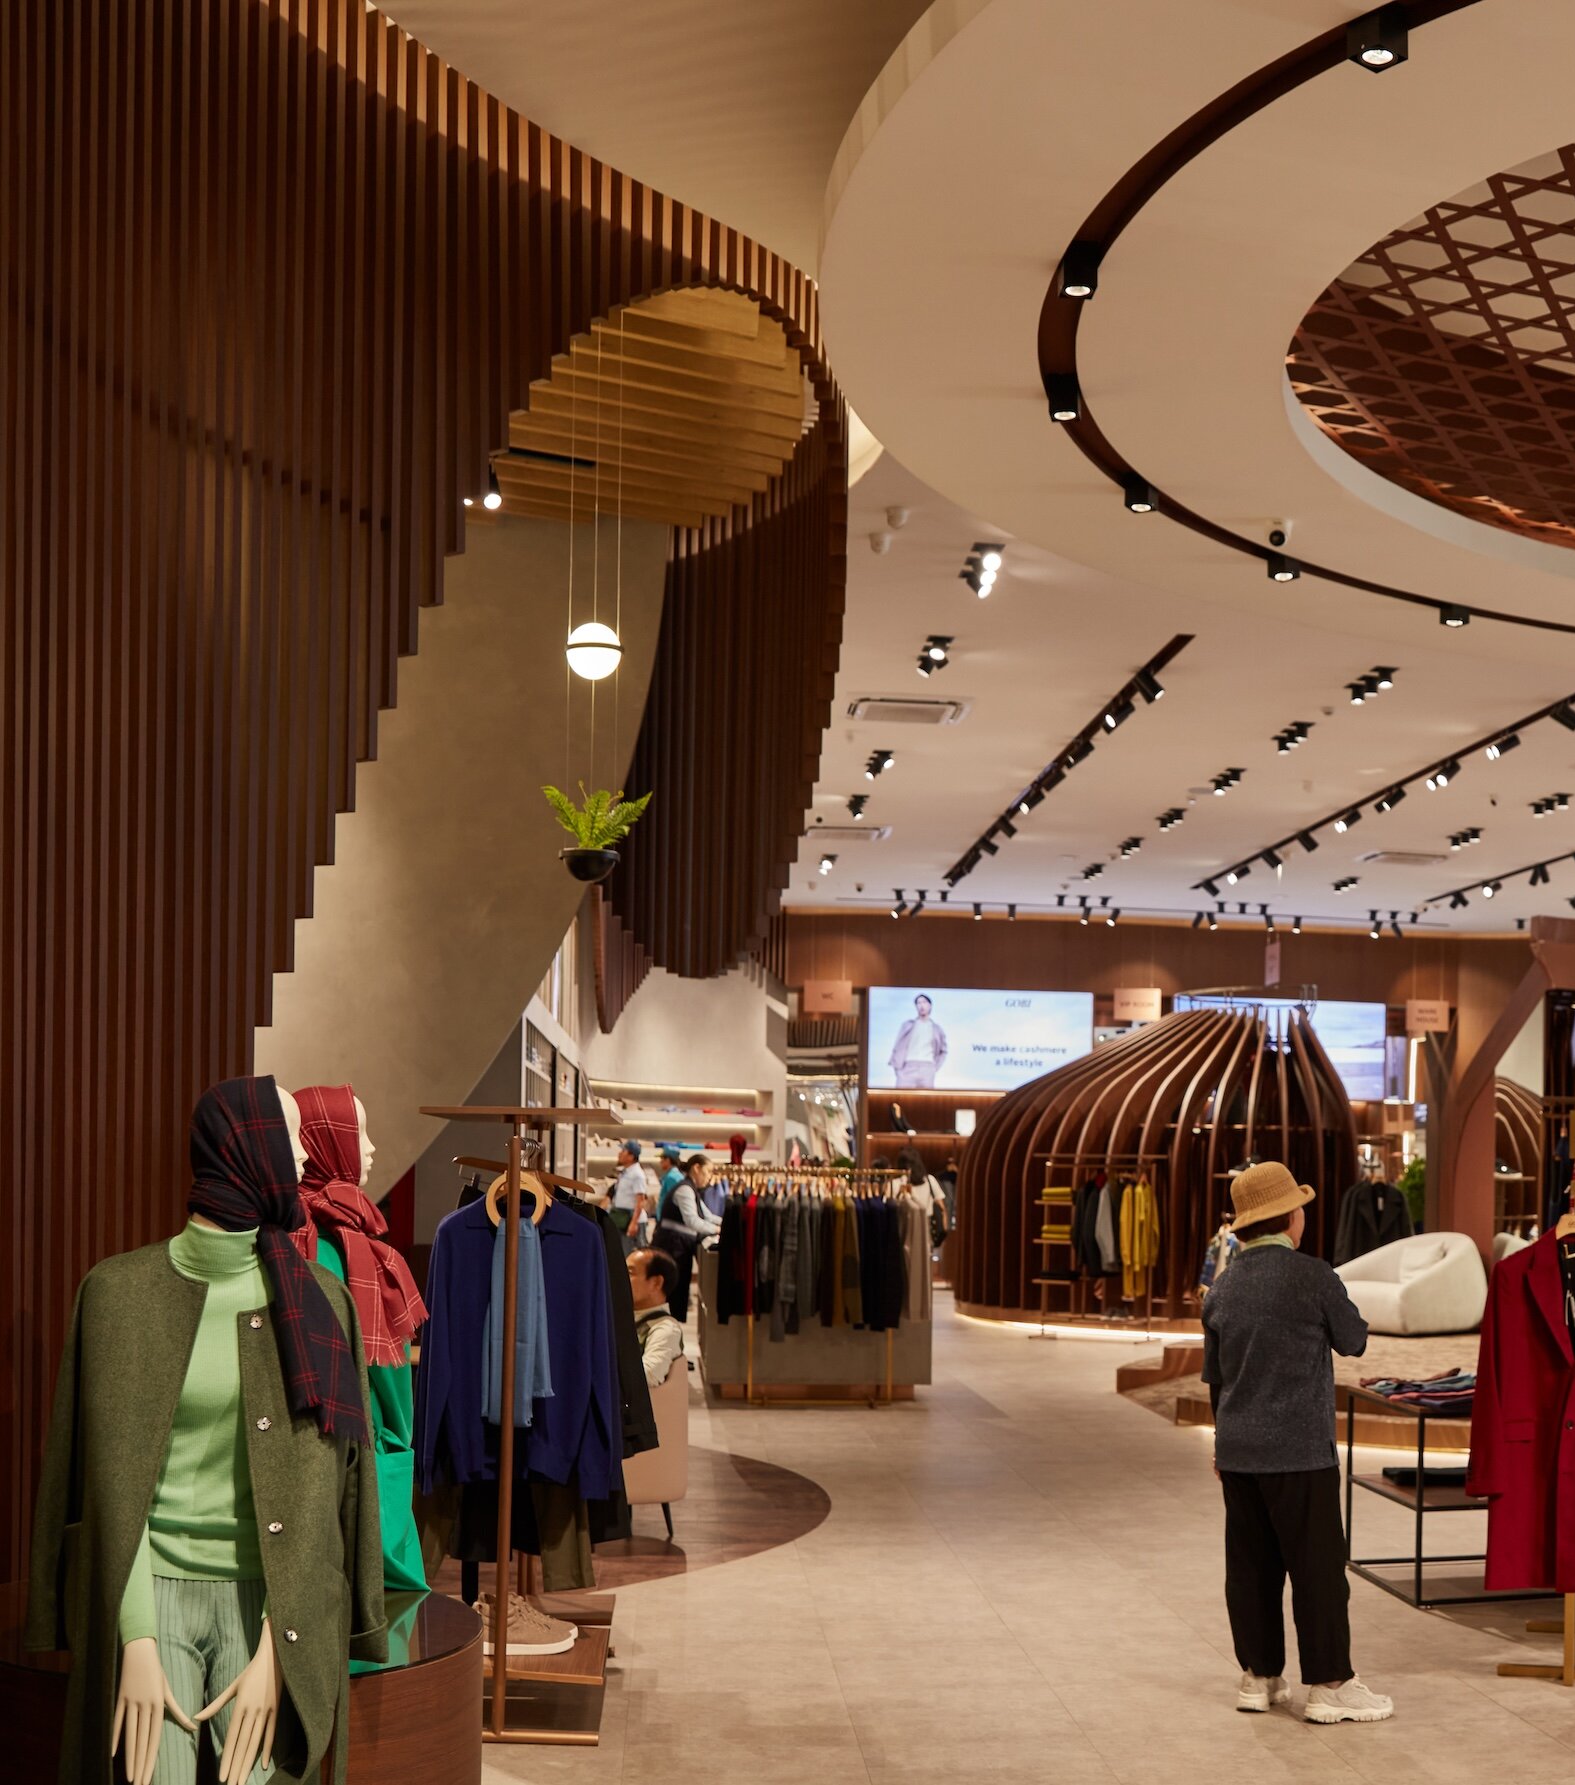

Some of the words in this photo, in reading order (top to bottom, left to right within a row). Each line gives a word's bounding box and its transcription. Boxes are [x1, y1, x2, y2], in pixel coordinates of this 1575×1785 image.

[1005, 998, 1032, 1009] GOBI
[972, 1043, 988, 1053] We
[990, 1044, 1016, 1054] make
[1018, 1044, 1067, 1055] cashmere
[1003, 1056, 1043, 1068] lifestyle
